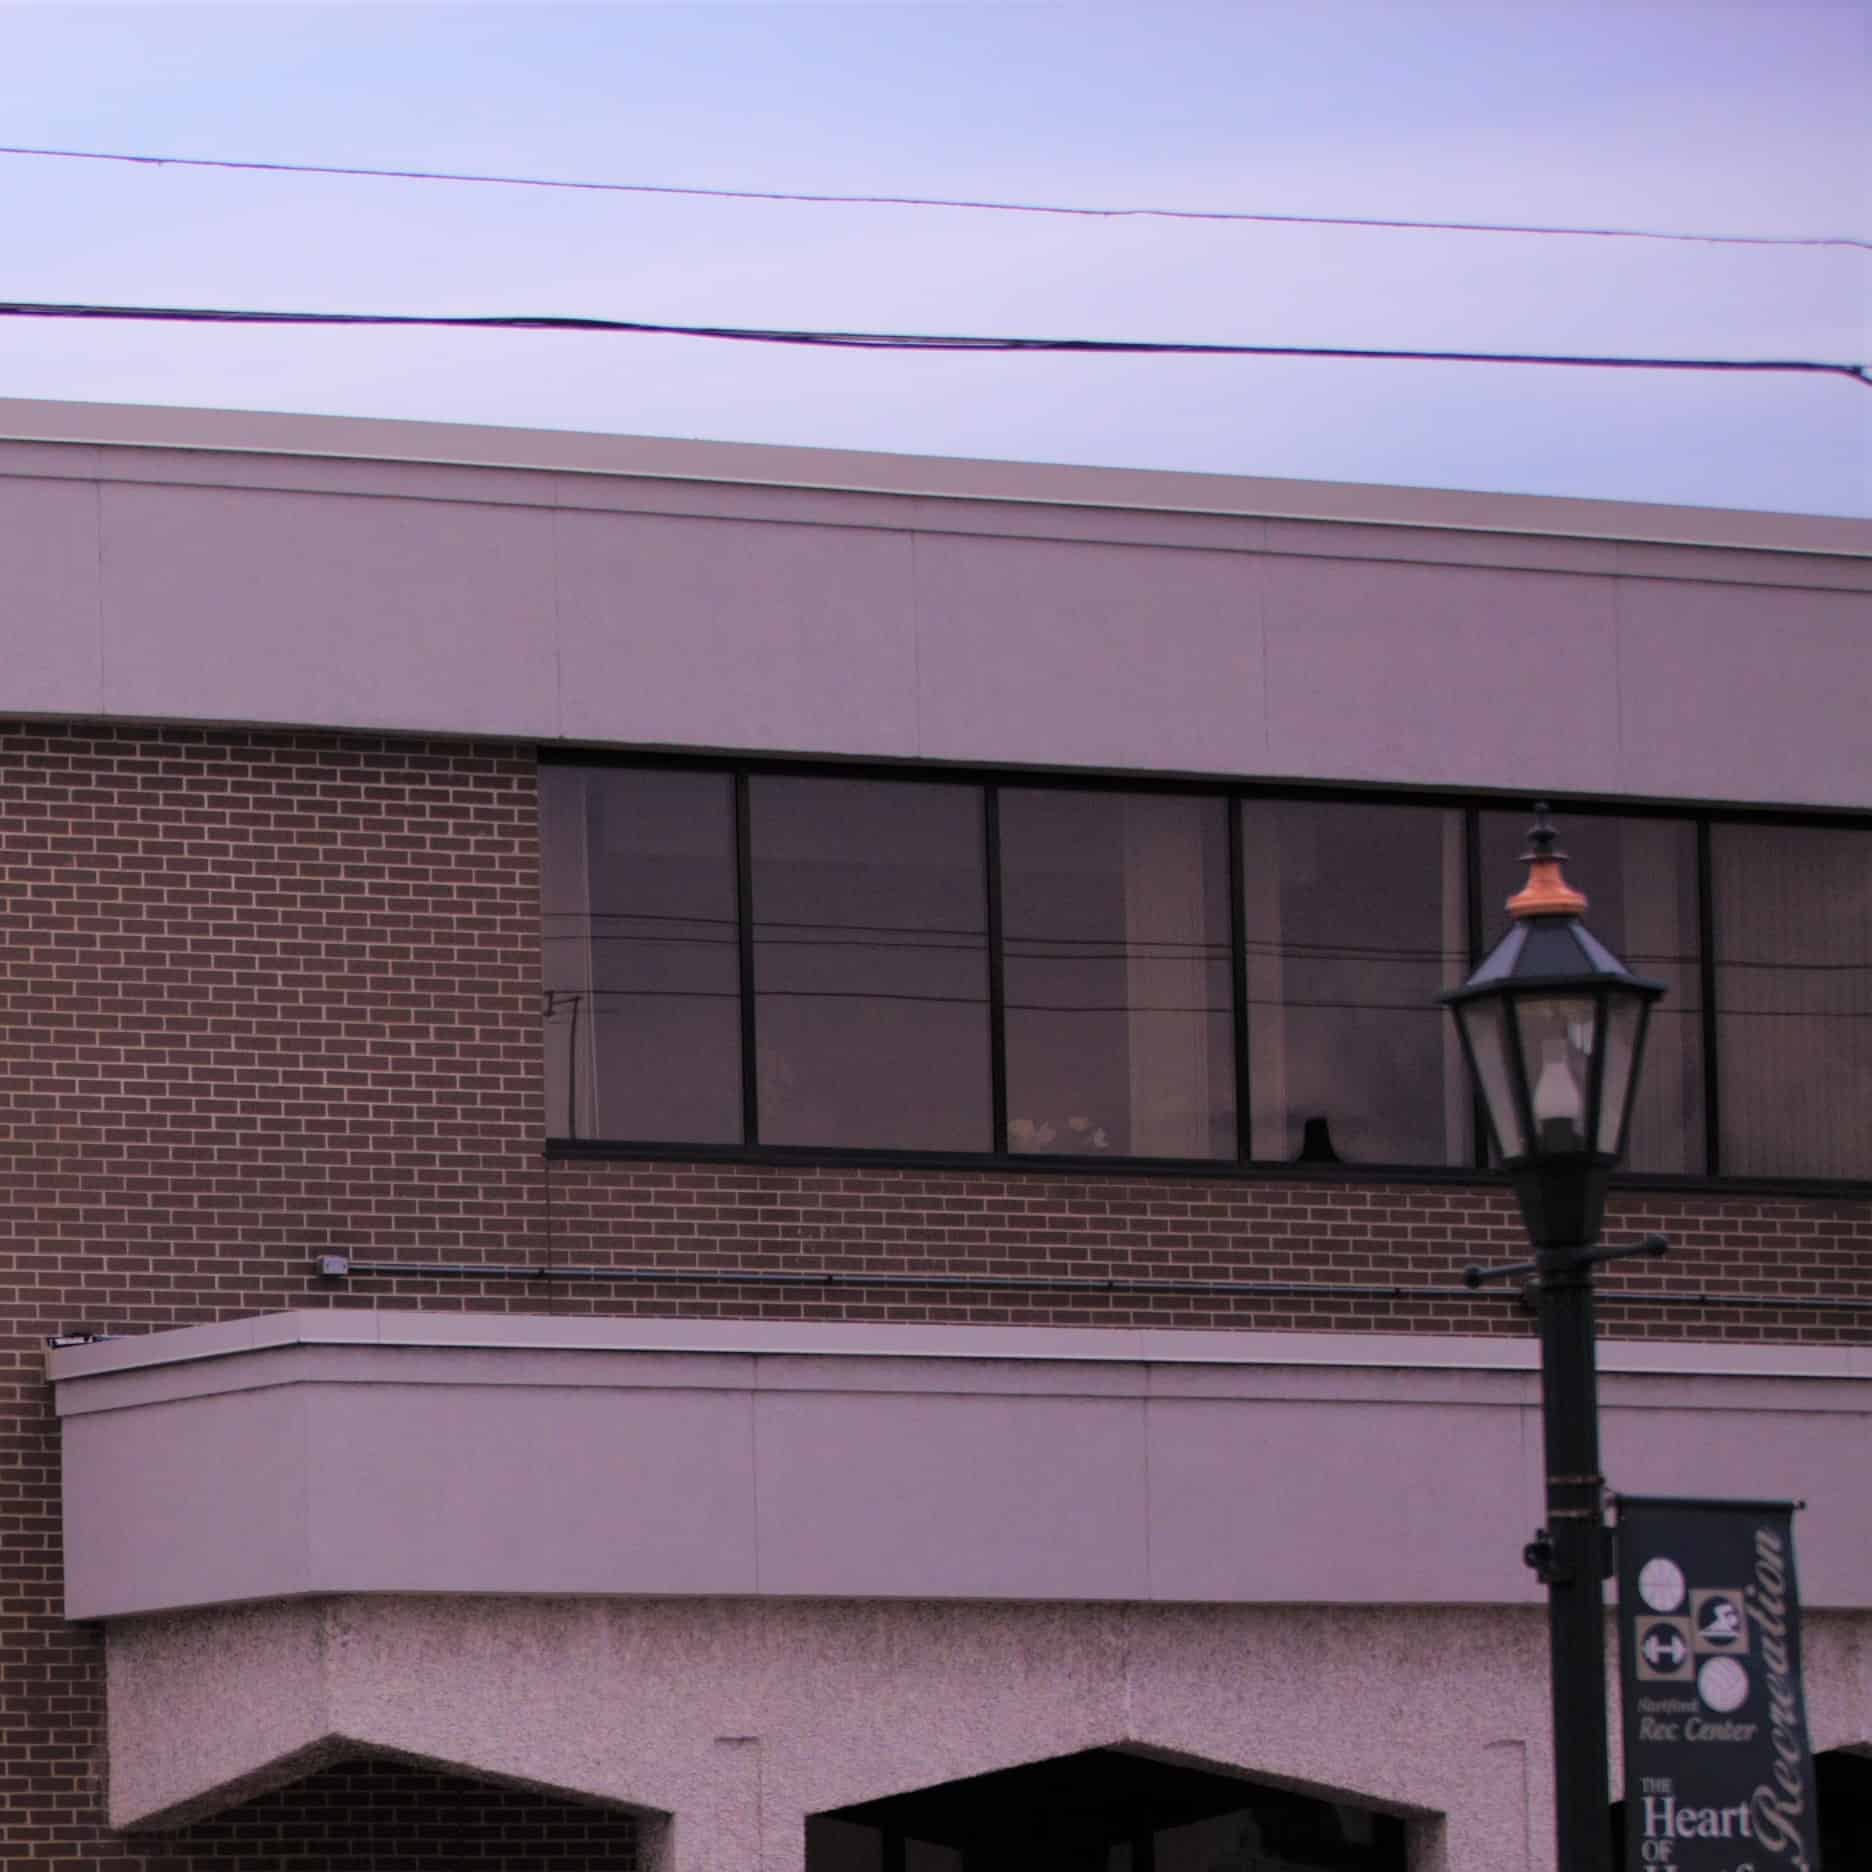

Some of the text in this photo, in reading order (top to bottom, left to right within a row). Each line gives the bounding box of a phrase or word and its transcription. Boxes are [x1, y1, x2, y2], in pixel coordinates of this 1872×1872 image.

[1745, 1527, 1806, 1866] Recreation
[1639, 1716, 1758, 1742] Rec Center
[1640, 1777, 1673, 1793] THE
[1642, 1798, 1753, 1838] Heart
[1641, 1839, 1674, 1863] OF
